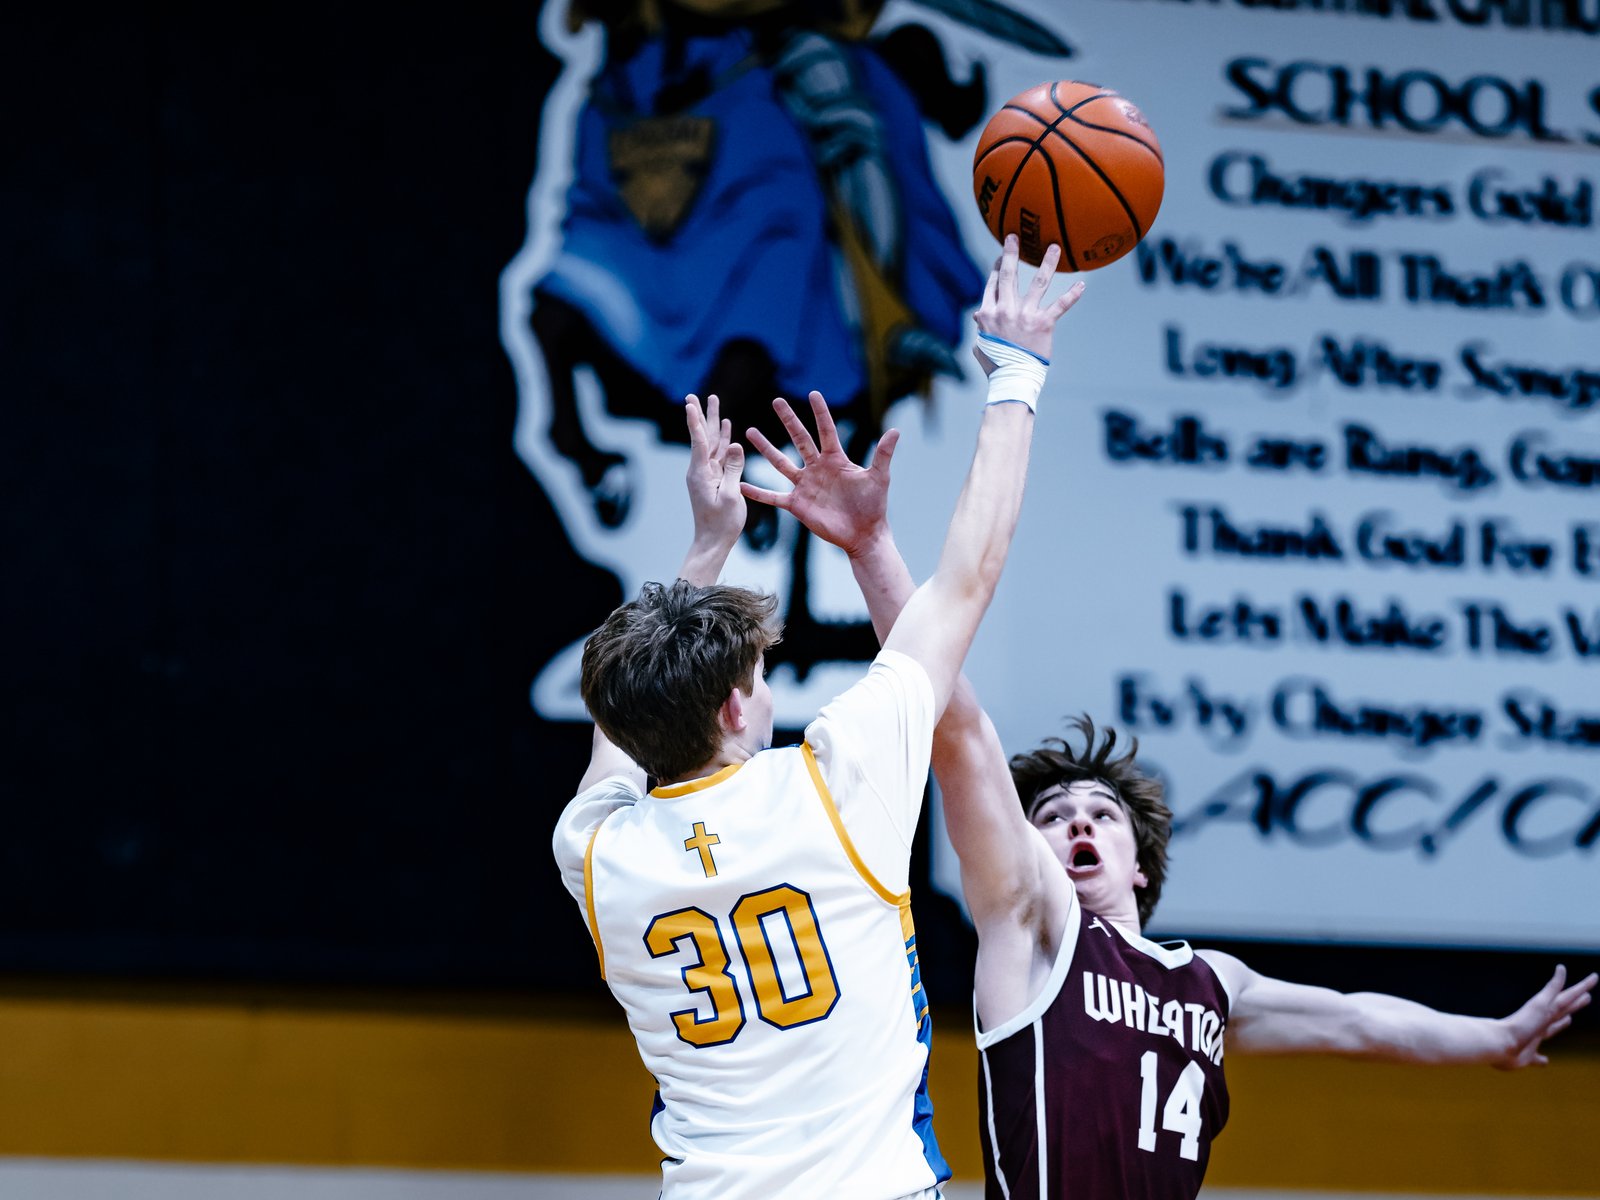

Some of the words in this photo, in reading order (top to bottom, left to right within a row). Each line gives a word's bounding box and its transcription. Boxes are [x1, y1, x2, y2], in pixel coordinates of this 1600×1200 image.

[1222, 54, 1572, 144] SCHOOL
[643, 882, 841, 1050] 30
[1136, 1050, 1206, 1163] 14
